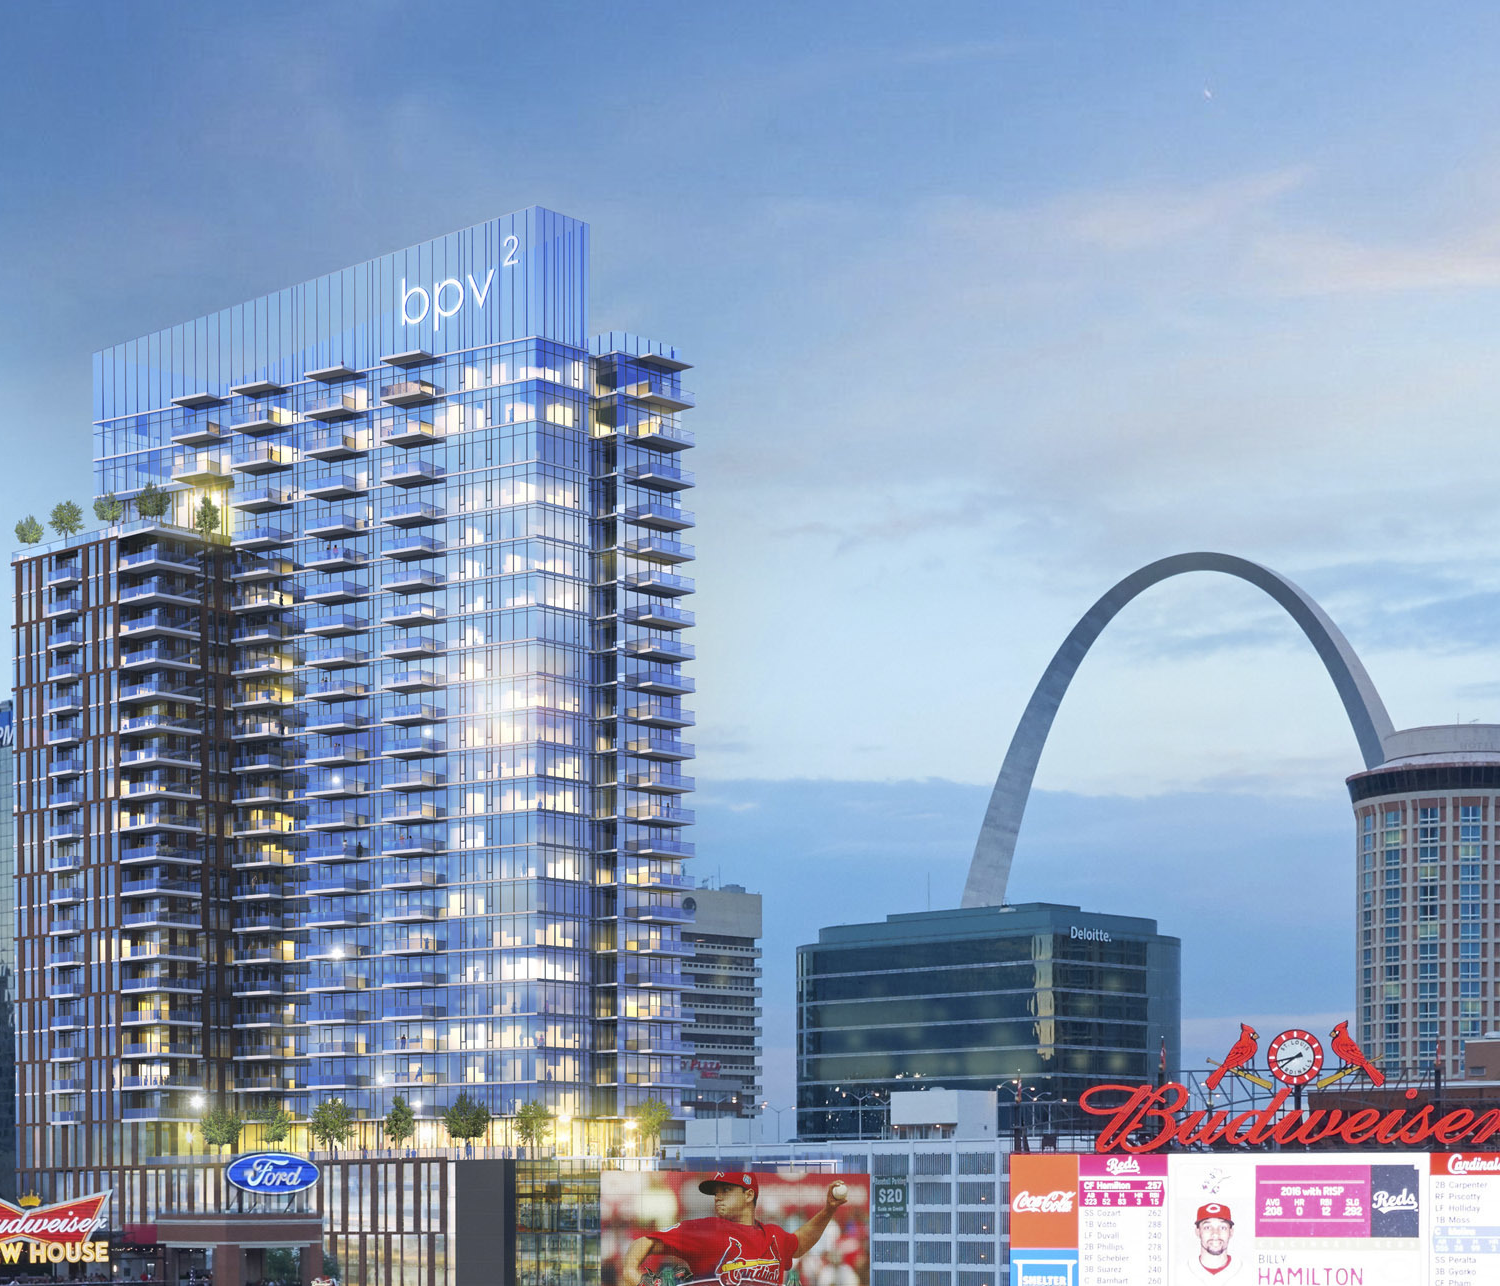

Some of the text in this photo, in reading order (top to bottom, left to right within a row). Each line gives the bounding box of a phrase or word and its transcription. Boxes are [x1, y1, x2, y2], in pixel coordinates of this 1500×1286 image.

[1291, 1040, 1309, 1051] LOUIS
[247, 1158, 302, 1187] Ford
[1106, 1155, 1141, 1176] Reds
[1448, 1181, 1488, 1190] Carpenter
[879, 1188, 902, 1204] $20
[1012, 1190, 1076, 1212] Coca-Cola
[1372, 1188, 1418, 1214] Reds
[1097, 1209, 1121, 1217] Cozart
[29, 1241, 110, 1264] HOUSE
[1258, 1254, 1287, 1264] BILLY
[1258, 1267, 1363, 1286] HAMILTON
